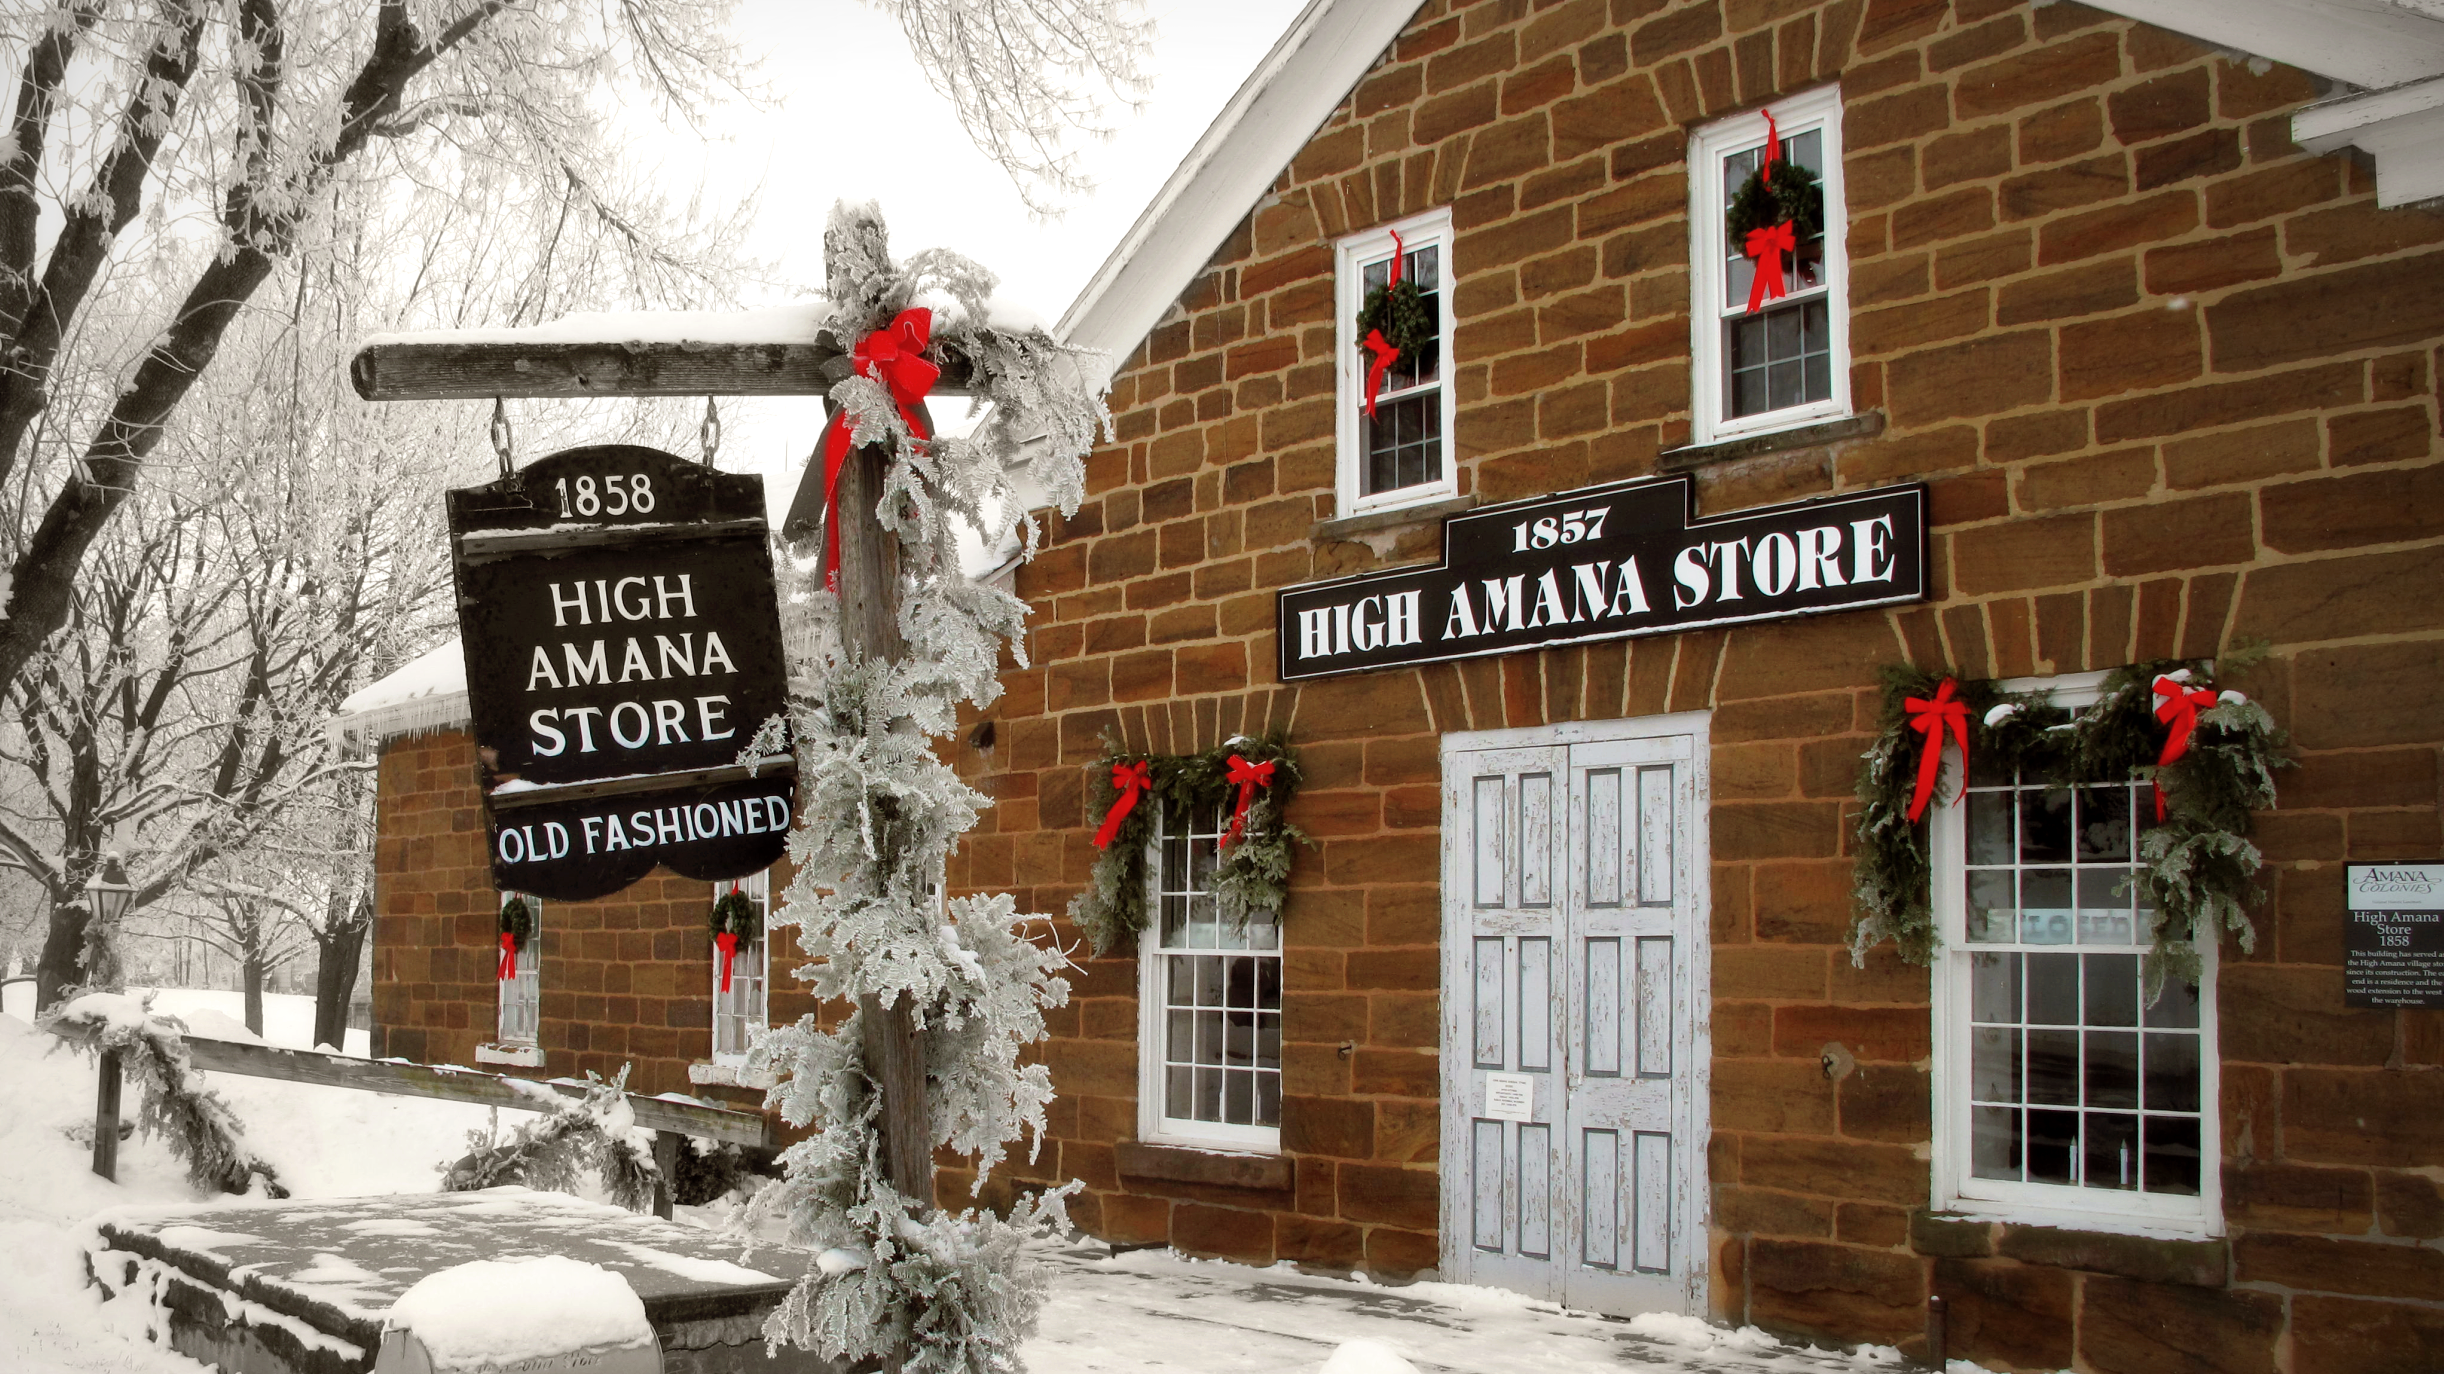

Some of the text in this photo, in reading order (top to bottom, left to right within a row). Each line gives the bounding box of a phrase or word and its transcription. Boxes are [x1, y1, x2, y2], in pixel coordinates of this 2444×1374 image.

[555, 473, 656, 518] 1858
[1512, 505, 1612, 554] 1857
[1297, 512, 1896, 661] HIGH AMANA STORE
[548, 573, 698, 627] HIGH
[525, 631, 739, 692] AMANA
[529, 695, 736, 757] STORE
[499, 795, 790, 864] OLD FASHIONED
[2355, 868, 2437, 883] AMANA
[2359, 882, 2435, 894] COLONIES
[2354, 911, 2439, 926] High Amana
[2376, 923, 2412, 935] Store
[2380, 935, 2410, 947] 1858
[2367, 950, 2398, 959] building
[2360, 960, 2378, 968] High
[2407, 960, 2431, 968] village
[2384, 997, 2425, 1005] warehouse.
